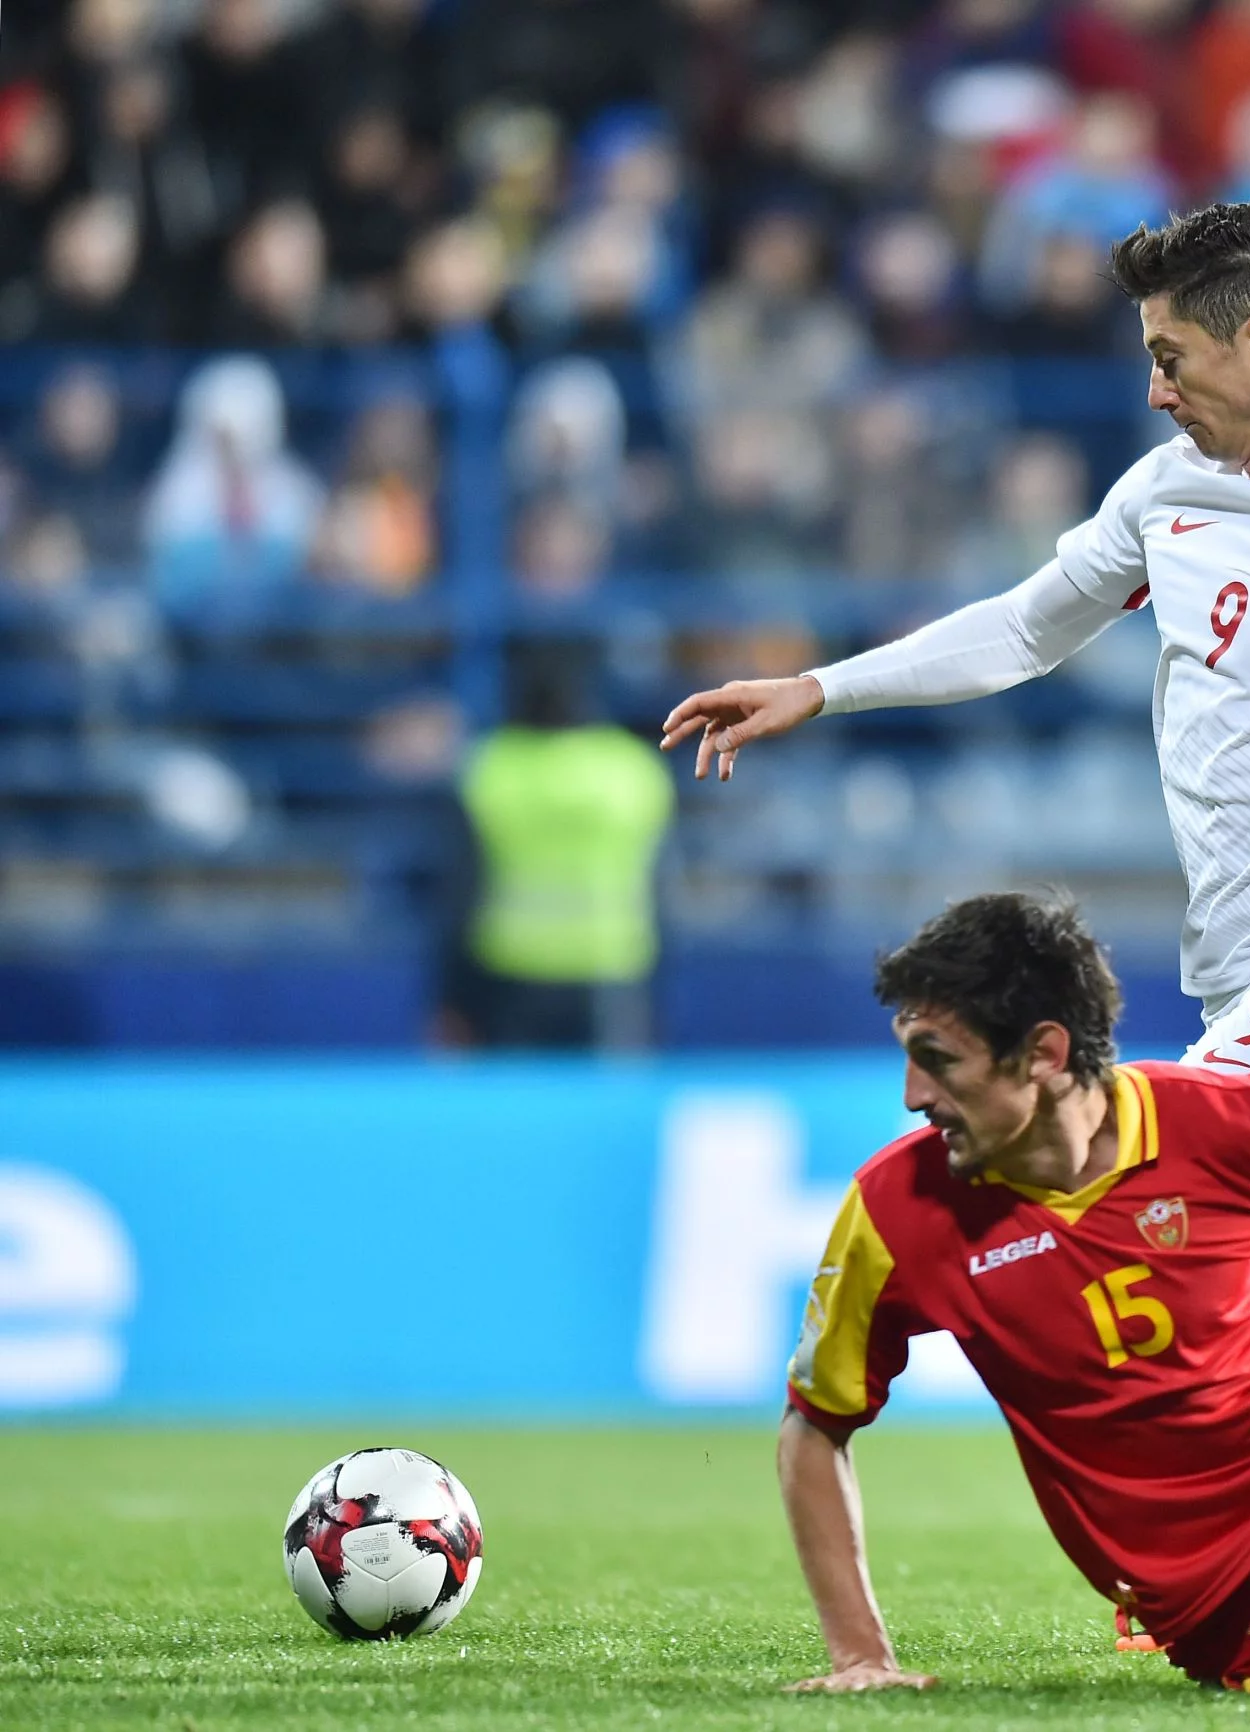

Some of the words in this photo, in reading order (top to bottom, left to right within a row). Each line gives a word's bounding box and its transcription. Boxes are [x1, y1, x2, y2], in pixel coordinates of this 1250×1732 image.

[1205, 580, 1249, 669] 9
[969, 1231, 1058, 1276] LEGEA
[1081, 1264, 1175, 1369] 15
